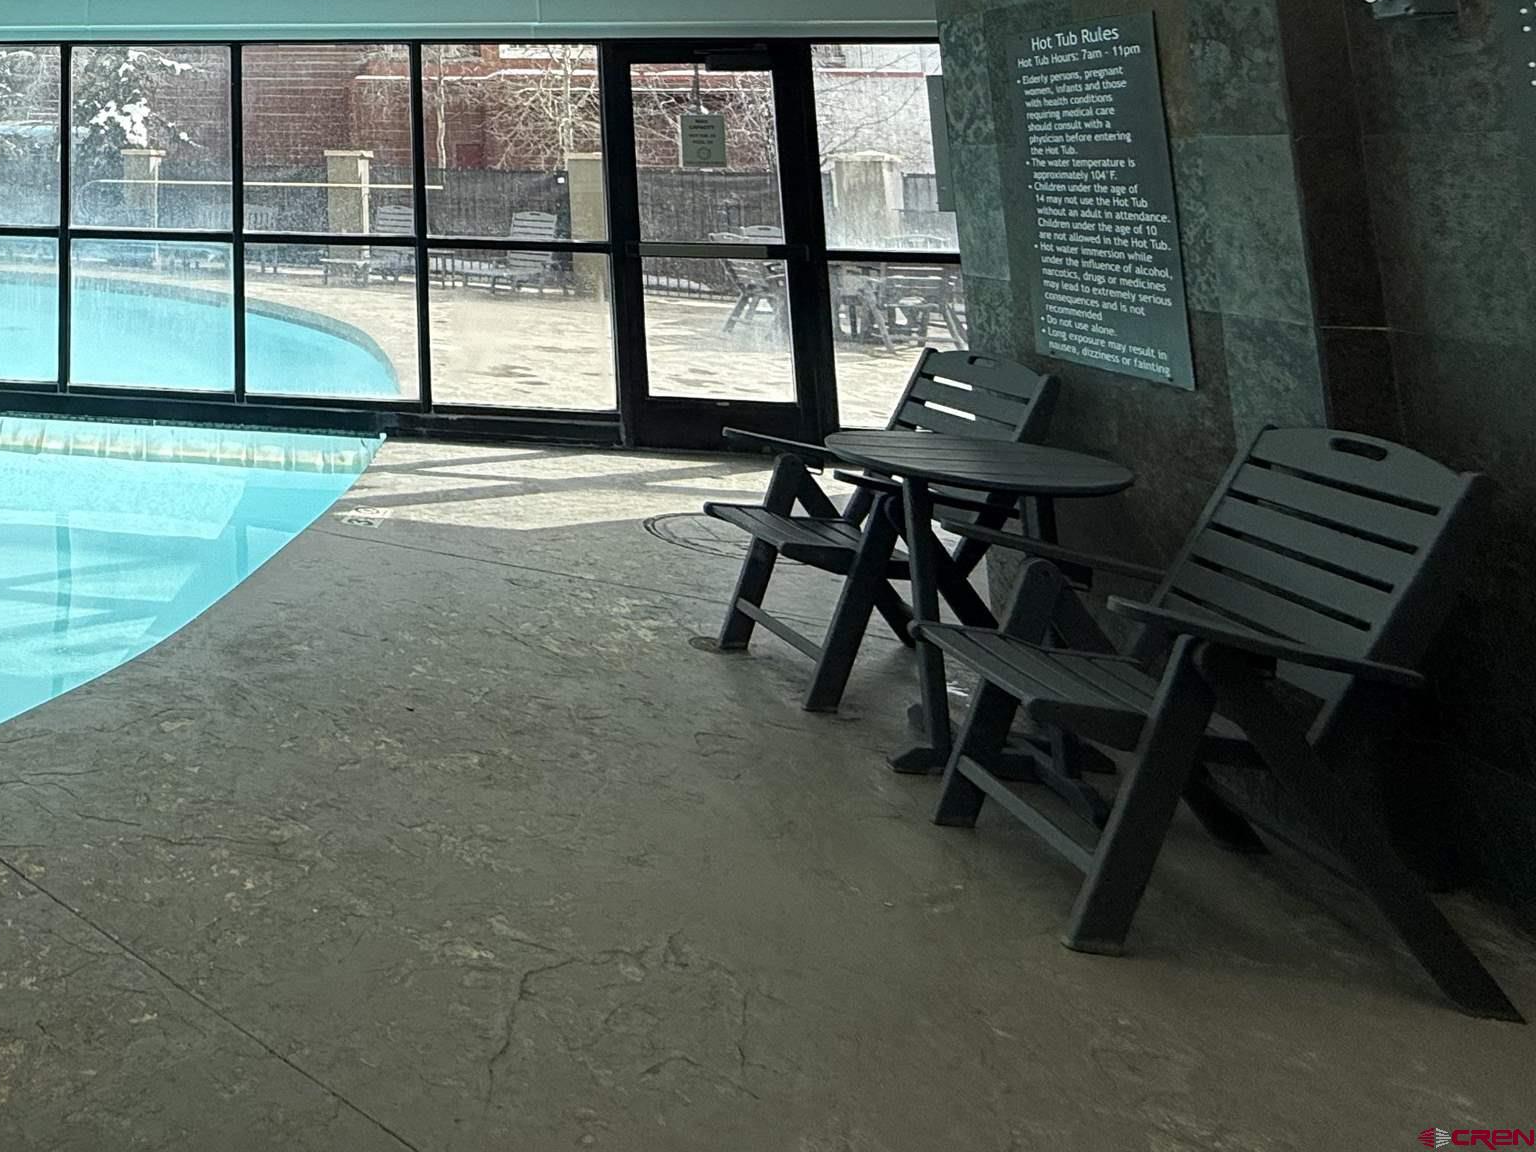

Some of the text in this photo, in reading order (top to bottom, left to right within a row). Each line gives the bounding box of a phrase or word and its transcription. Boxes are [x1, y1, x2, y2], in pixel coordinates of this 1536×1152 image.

[1031, 27, 1120, 51] Hot Tub Rules
[1017, 58, 1032, 68] Hot
[1034, 55, 1049, 65] Tub
[1051, 53, 1079, 64] Hours:
[1081, 49, 1102, 60] 7am
[1112, 44, 1140, 58] 11pm
[1023, 66, 1123, 85] Elderly persons, pregnant
[1024, 79, 1127, 96] women, infants and those
[1025, 94, 1112, 107] with health conditions
[1026, 110, 1060, 120] requiring
[1062, 106, 1092, 117] medical
[1028, 122, 1052, 131] should
[1054, 120, 1082, 129] consult
[1084, 120, 1102, 128] with
[1029, 131, 1132, 145] physician before entering
[1031, 146, 1078, 155] the Hot Tub.
[1032, 158, 1136, 168] The water temperature is
[1033, 171, 1088, 181] approximately
[1034, 183, 1138, 195] Children under the age of
[1046, 196, 1062, 204] may
[1064, 196, 1077, 204] not
[1080, 197, 1094, 205] use
[1096, 196, 1110, 206] the
[1113, 196, 1128, 207] Hot
[1132, 196, 1148, 208] Tub
[1037, 207, 1066, 216] without
[1080, 208, 1102, 218] adult
[1105, 209, 1112, 218] in
[1115, 211, 1171, 223] attendance.
[1038, 218, 1157, 235] Children under the age of 10
[1039, 232, 1171, 251] are not allowed in the Hot Tub.
[1040, 242, 1152, 262] Hot water immersion while
[1041, 256, 1173, 280] under the influence of alcohol,
[1042, 268, 1166, 292] narcotics, drugs or medicines
[1043, 280, 1172, 306] may lead to extremely serious
[1044, 291, 1099, 308] consequences
[1102, 298, 1117, 311] and
[1120, 302, 1128, 312] is
[1046, 315, 1057, 325] Do
[1059, 317, 1072, 327] not
[1075, 320, 1089, 330] use
[1048, 328, 1167, 360] Long exposure may result in
[1049, 341, 1079, 355] nausea,
[1082, 347, 1120, 364] dizziness
[1122, 356, 1131, 366] or
